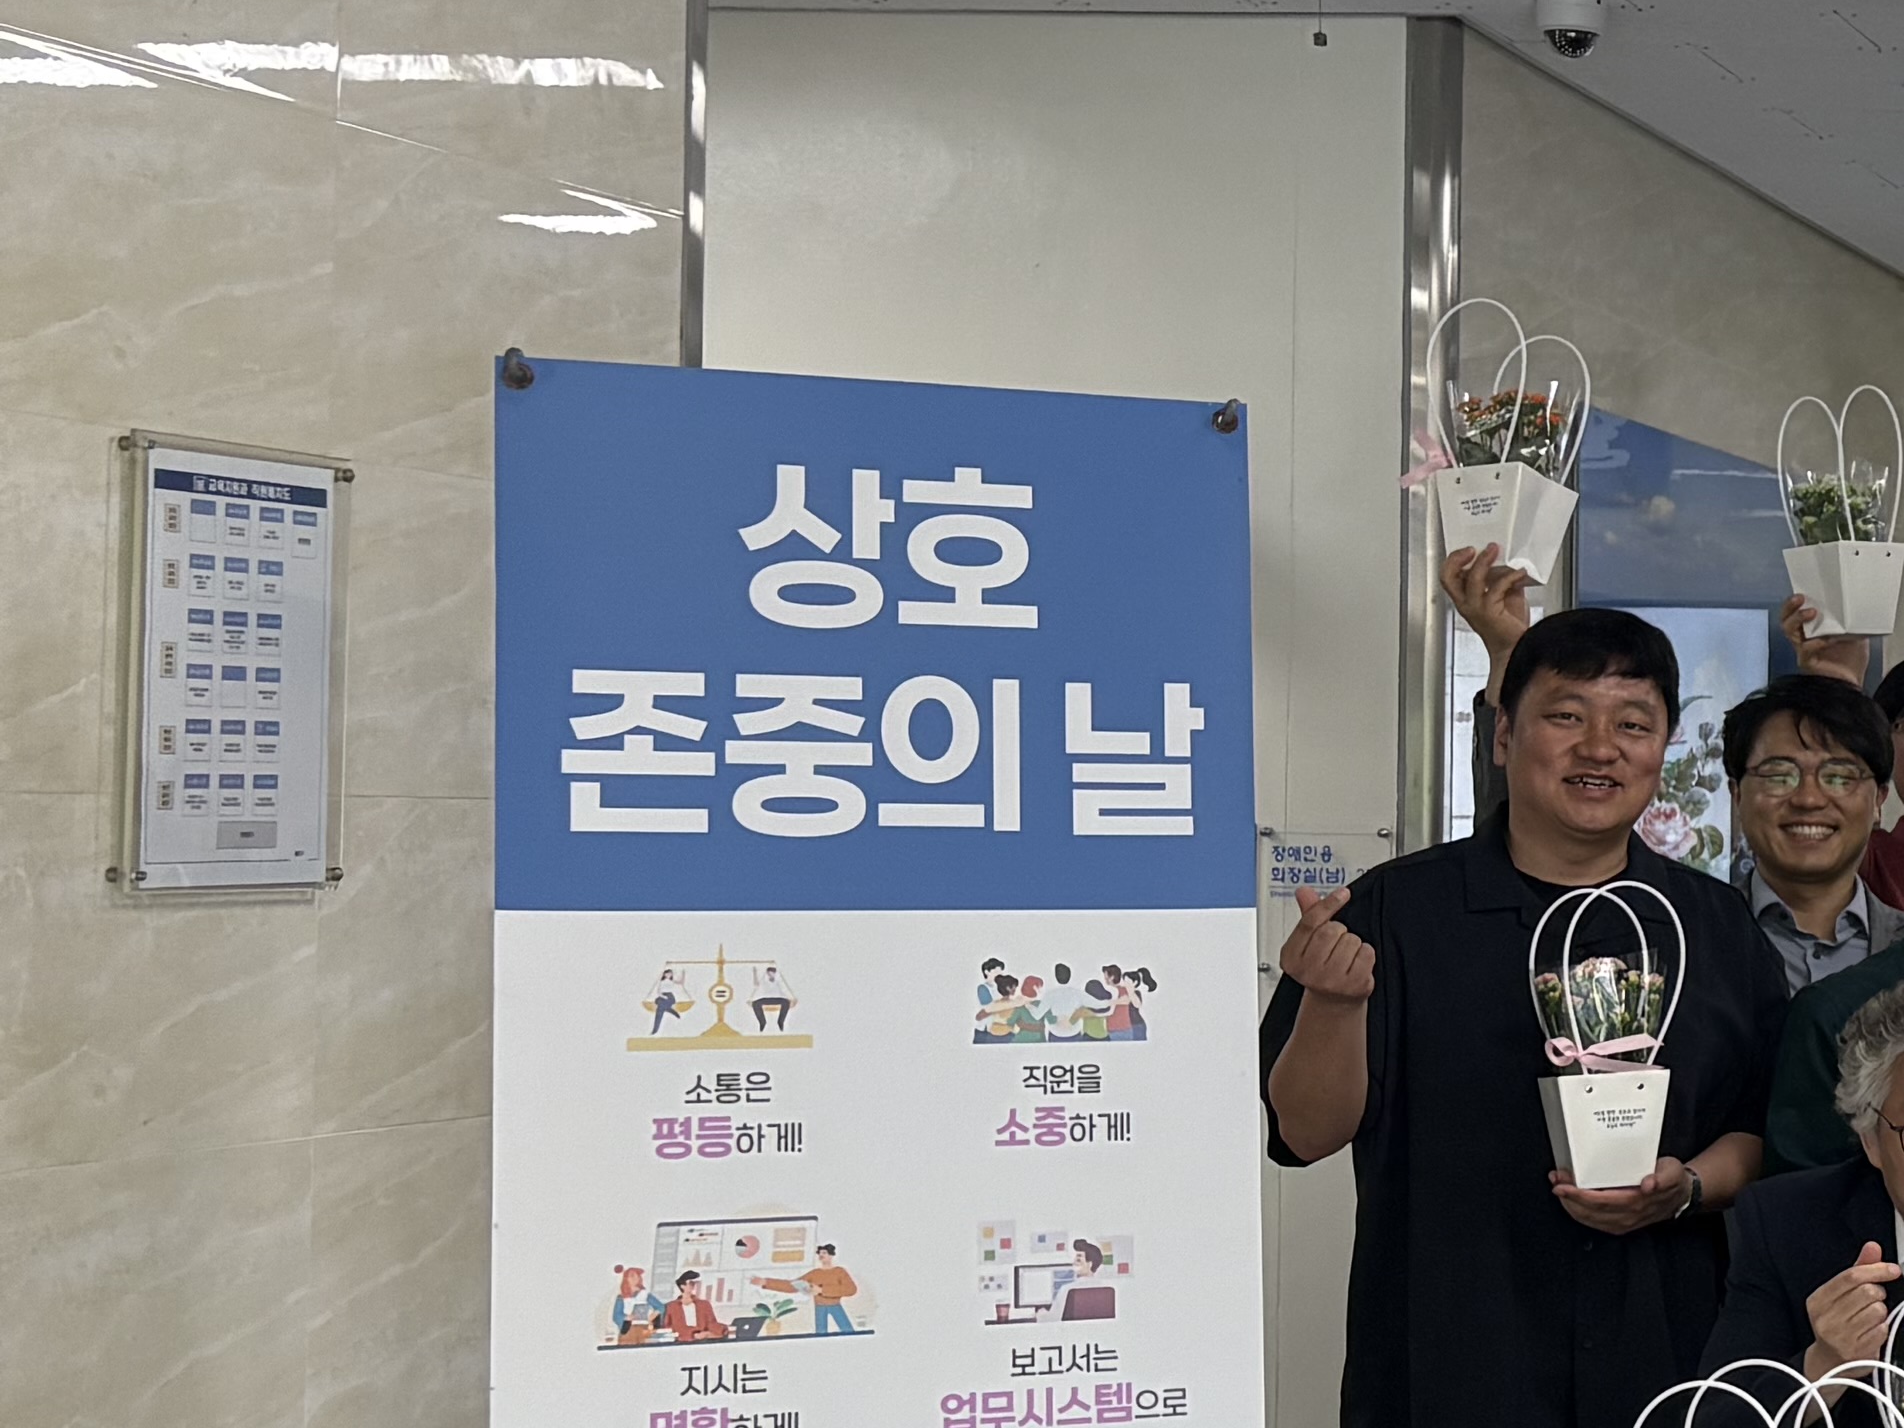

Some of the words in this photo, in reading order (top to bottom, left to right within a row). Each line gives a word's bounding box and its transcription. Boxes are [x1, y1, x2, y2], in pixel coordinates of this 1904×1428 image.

[737, 463, 1038, 629] 상호
[561, 668, 1020, 837] 존중의
[1065, 682, 1204, 835] 날
[684, 1071, 772, 1104] 소통은
[1022, 1064, 1102, 1095] 직원을
[651, 1116, 803, 1160] 평등하게!
[995, 1106, 1131, 1147] 소중하게!
[1011, 1343, 1118, 1377] 보고서는
[680, 1363, 768, 1396] 지시는
